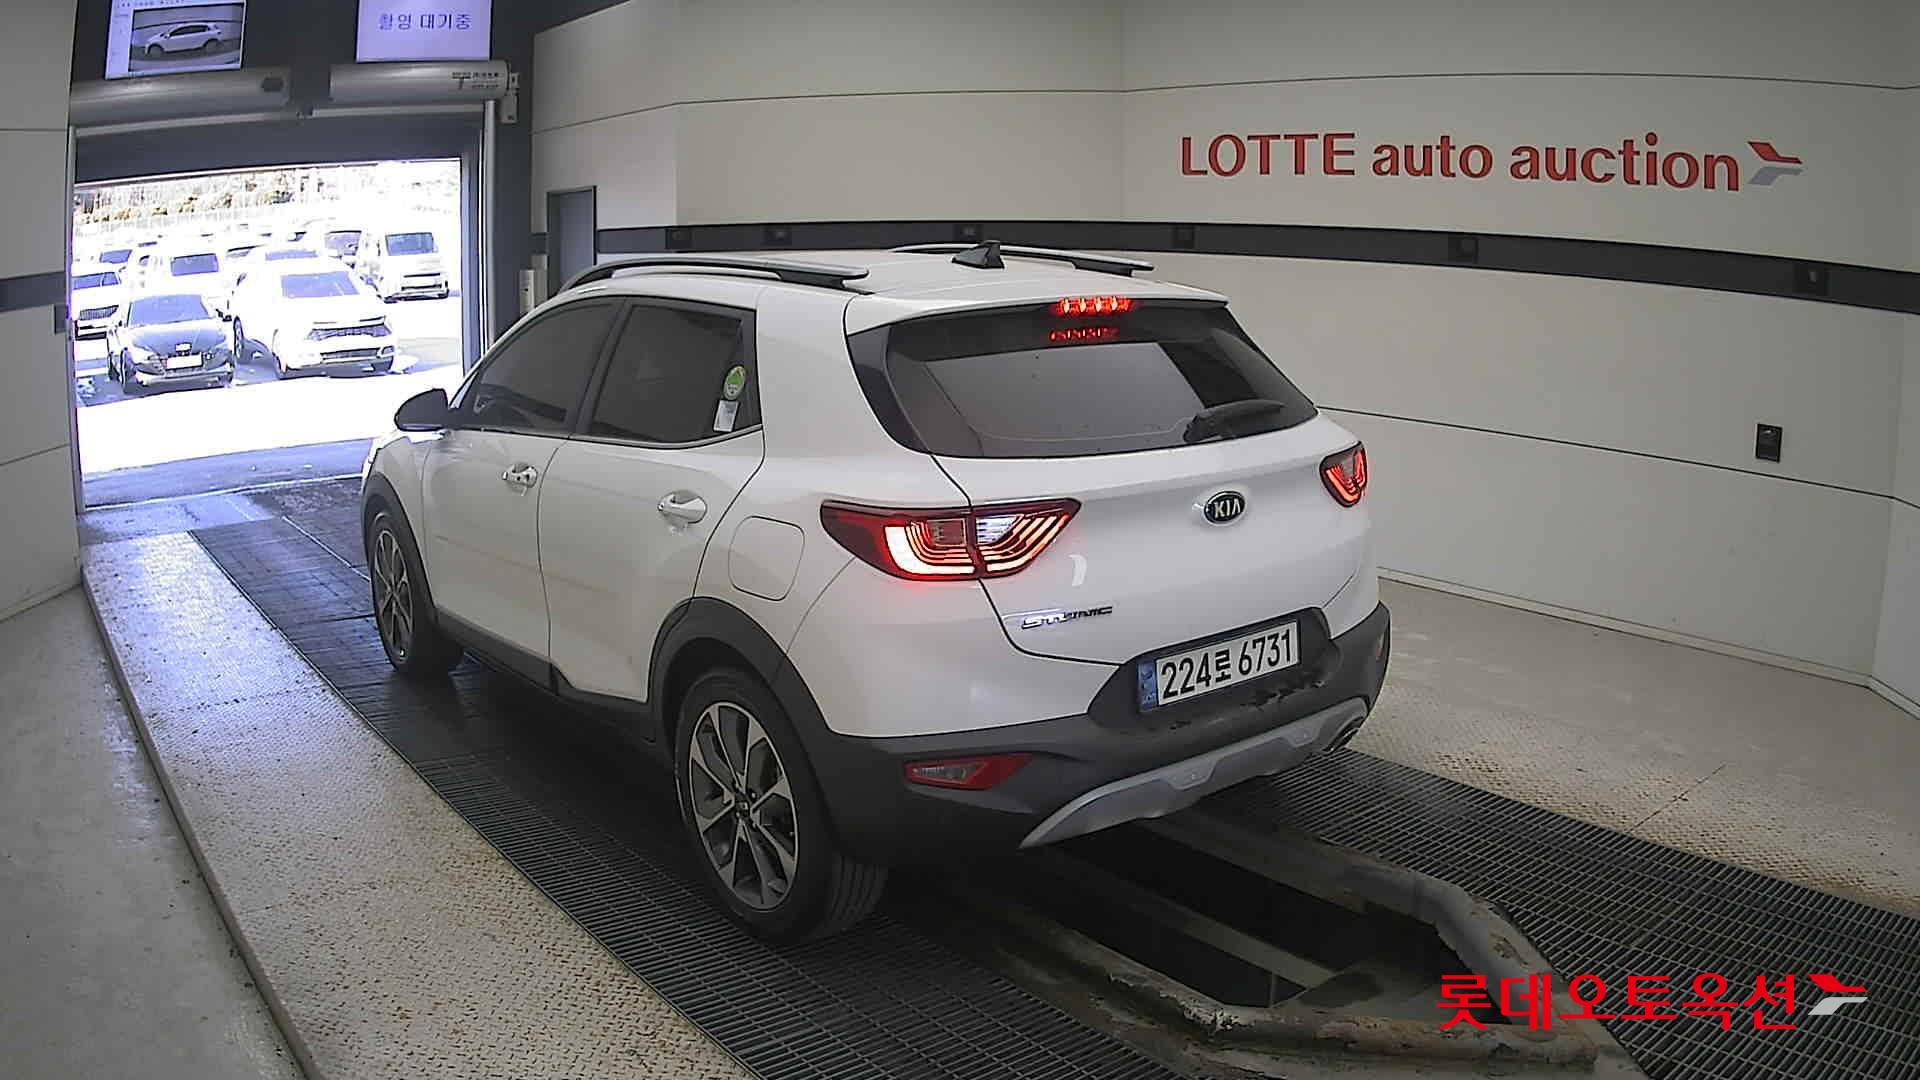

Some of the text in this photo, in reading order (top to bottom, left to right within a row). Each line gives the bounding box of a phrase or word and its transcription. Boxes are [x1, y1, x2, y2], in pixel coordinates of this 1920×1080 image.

[420, 13, 471, 30] 대기중
[1181, 131, 1740, 192] LOTTE auto auction
[1213, 498, 1241, 519] KIA
[1161, 628, 1291, 699] 224로 6731
